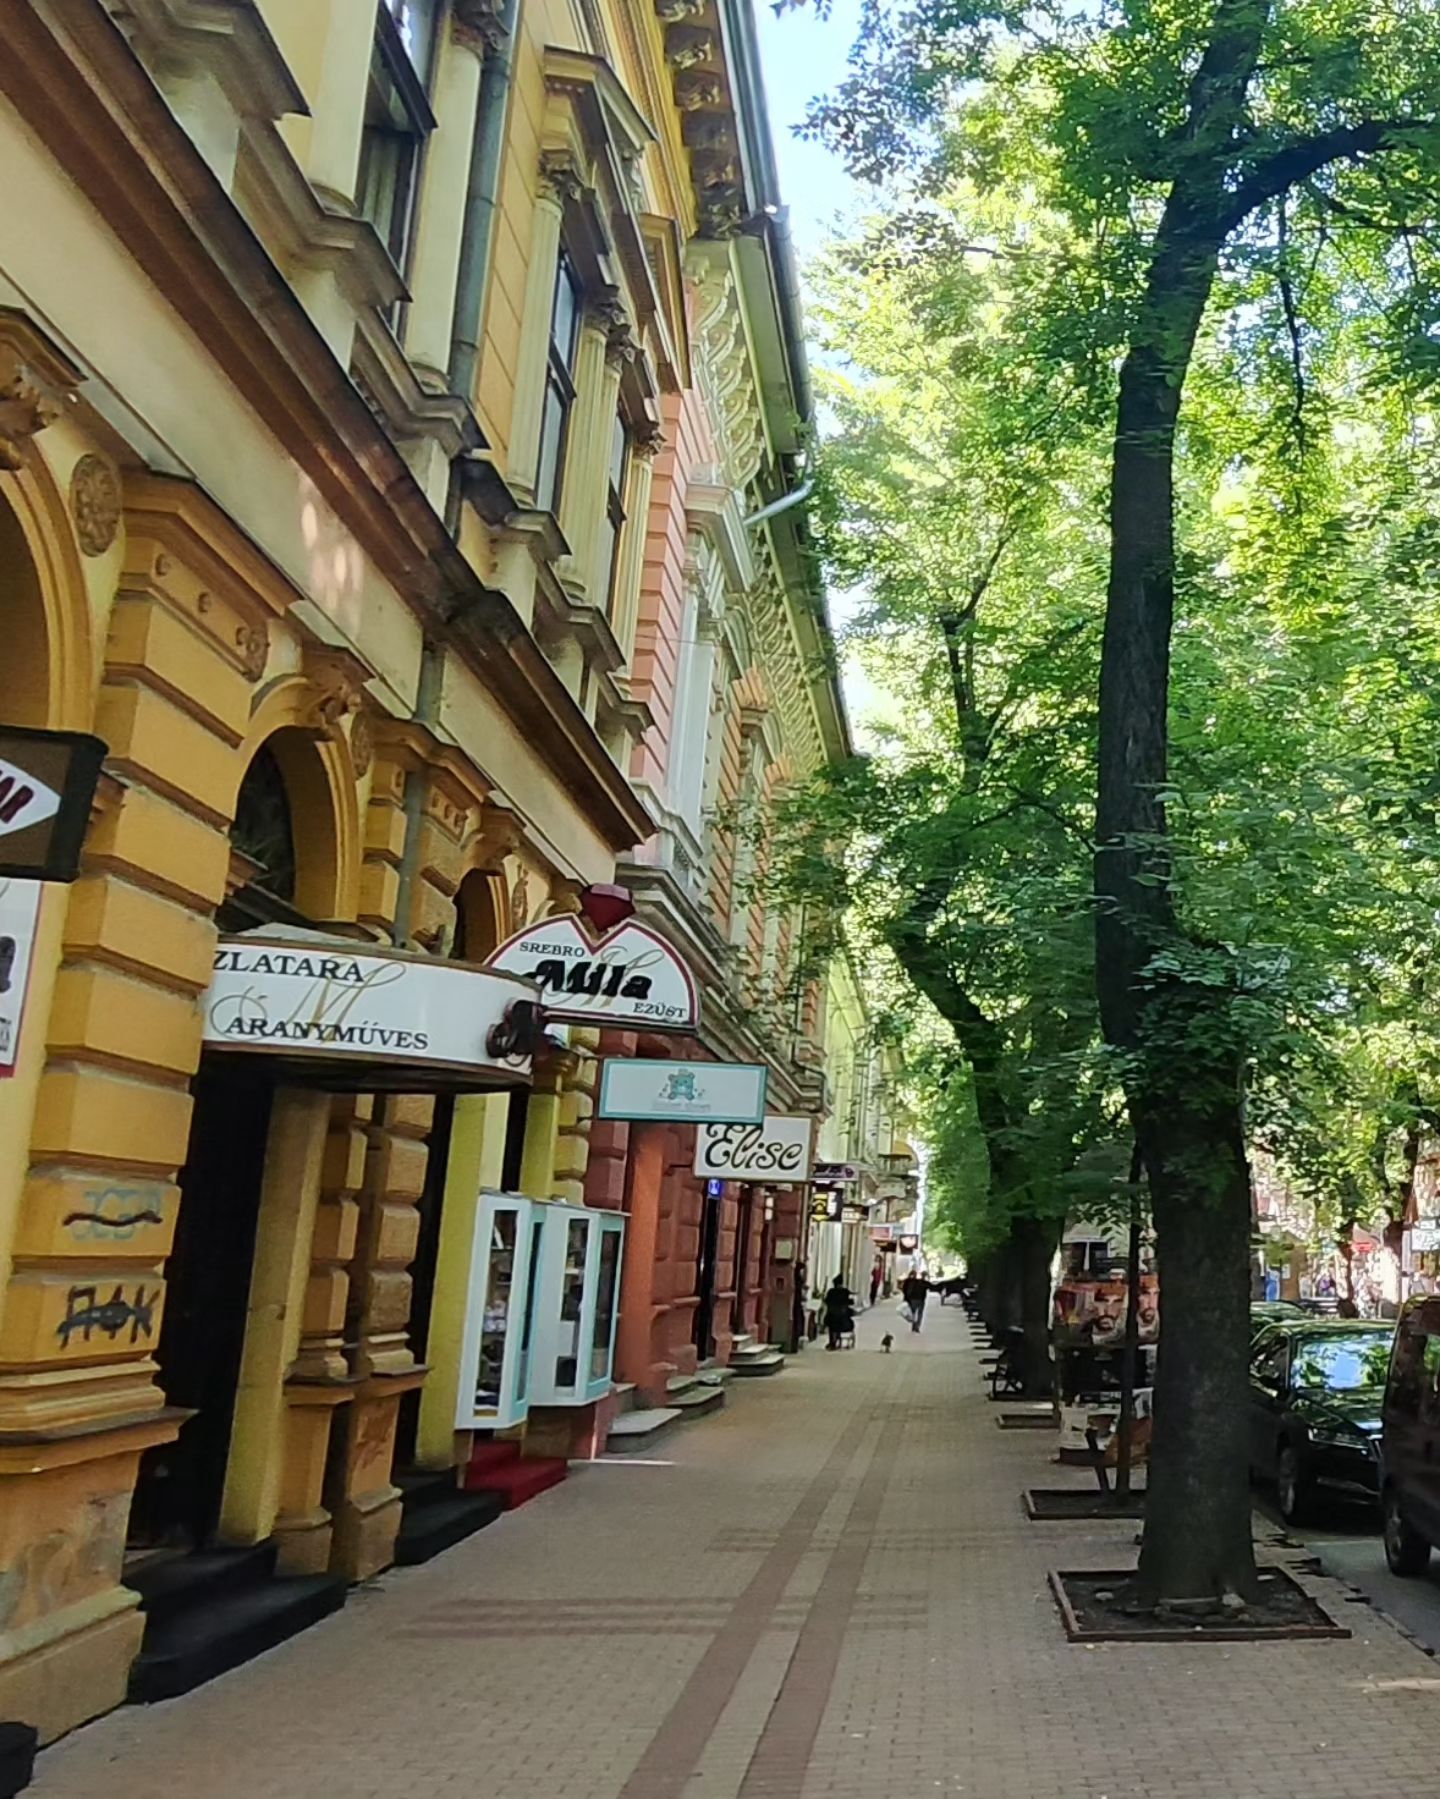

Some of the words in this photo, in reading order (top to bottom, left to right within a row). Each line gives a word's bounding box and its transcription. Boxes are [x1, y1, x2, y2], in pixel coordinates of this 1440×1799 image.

[519, 941, 586, 958] SREBRO
[213, 950, 364, 982] ZLATARA
[632, 1002, 687, 1018] EZÜST
[224, 1016, 428, 1050] ARANYMŰVES
[705, 1123, 803, 1170] Elise
